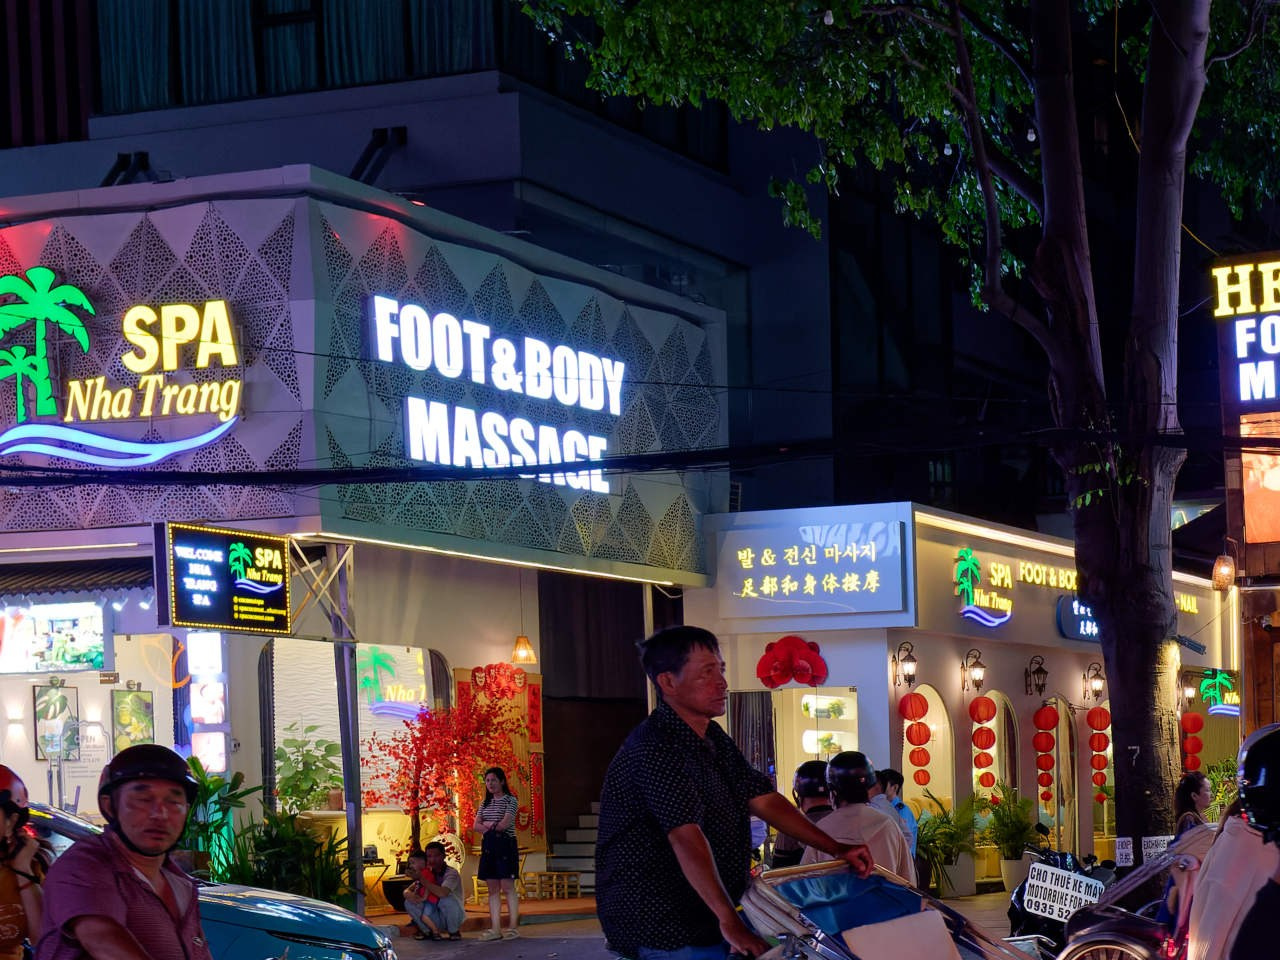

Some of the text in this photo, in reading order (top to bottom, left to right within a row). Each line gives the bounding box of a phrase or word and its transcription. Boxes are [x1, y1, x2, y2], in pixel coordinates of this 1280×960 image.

[121, 299, 239, 374] SPA
[63, 373, 241, 424] Nha Trang
[407, 396, 611, 494] MASSAGE
[255, 547, 283, 570] SPA
[737, 541, 877, 569] 발 & 전신 마사지
[246, 567, 283, 585] Nha Trang
[990, 562, 1013, 589] SPA
[1019, 561, 1047, 587] FOOT
[1049, 567, 1057, 588] &
[1030, 866, 1048, 883] CHO
[1049, 869, 1072, 891] THUÊ
[1072, 878, 1085, 894] XE
[1026, 883, 1069, 908] MOTORBIKE
[1069, 894, 1083, 909] FOR
[1026, 898, 1071, 921] 0935 52
